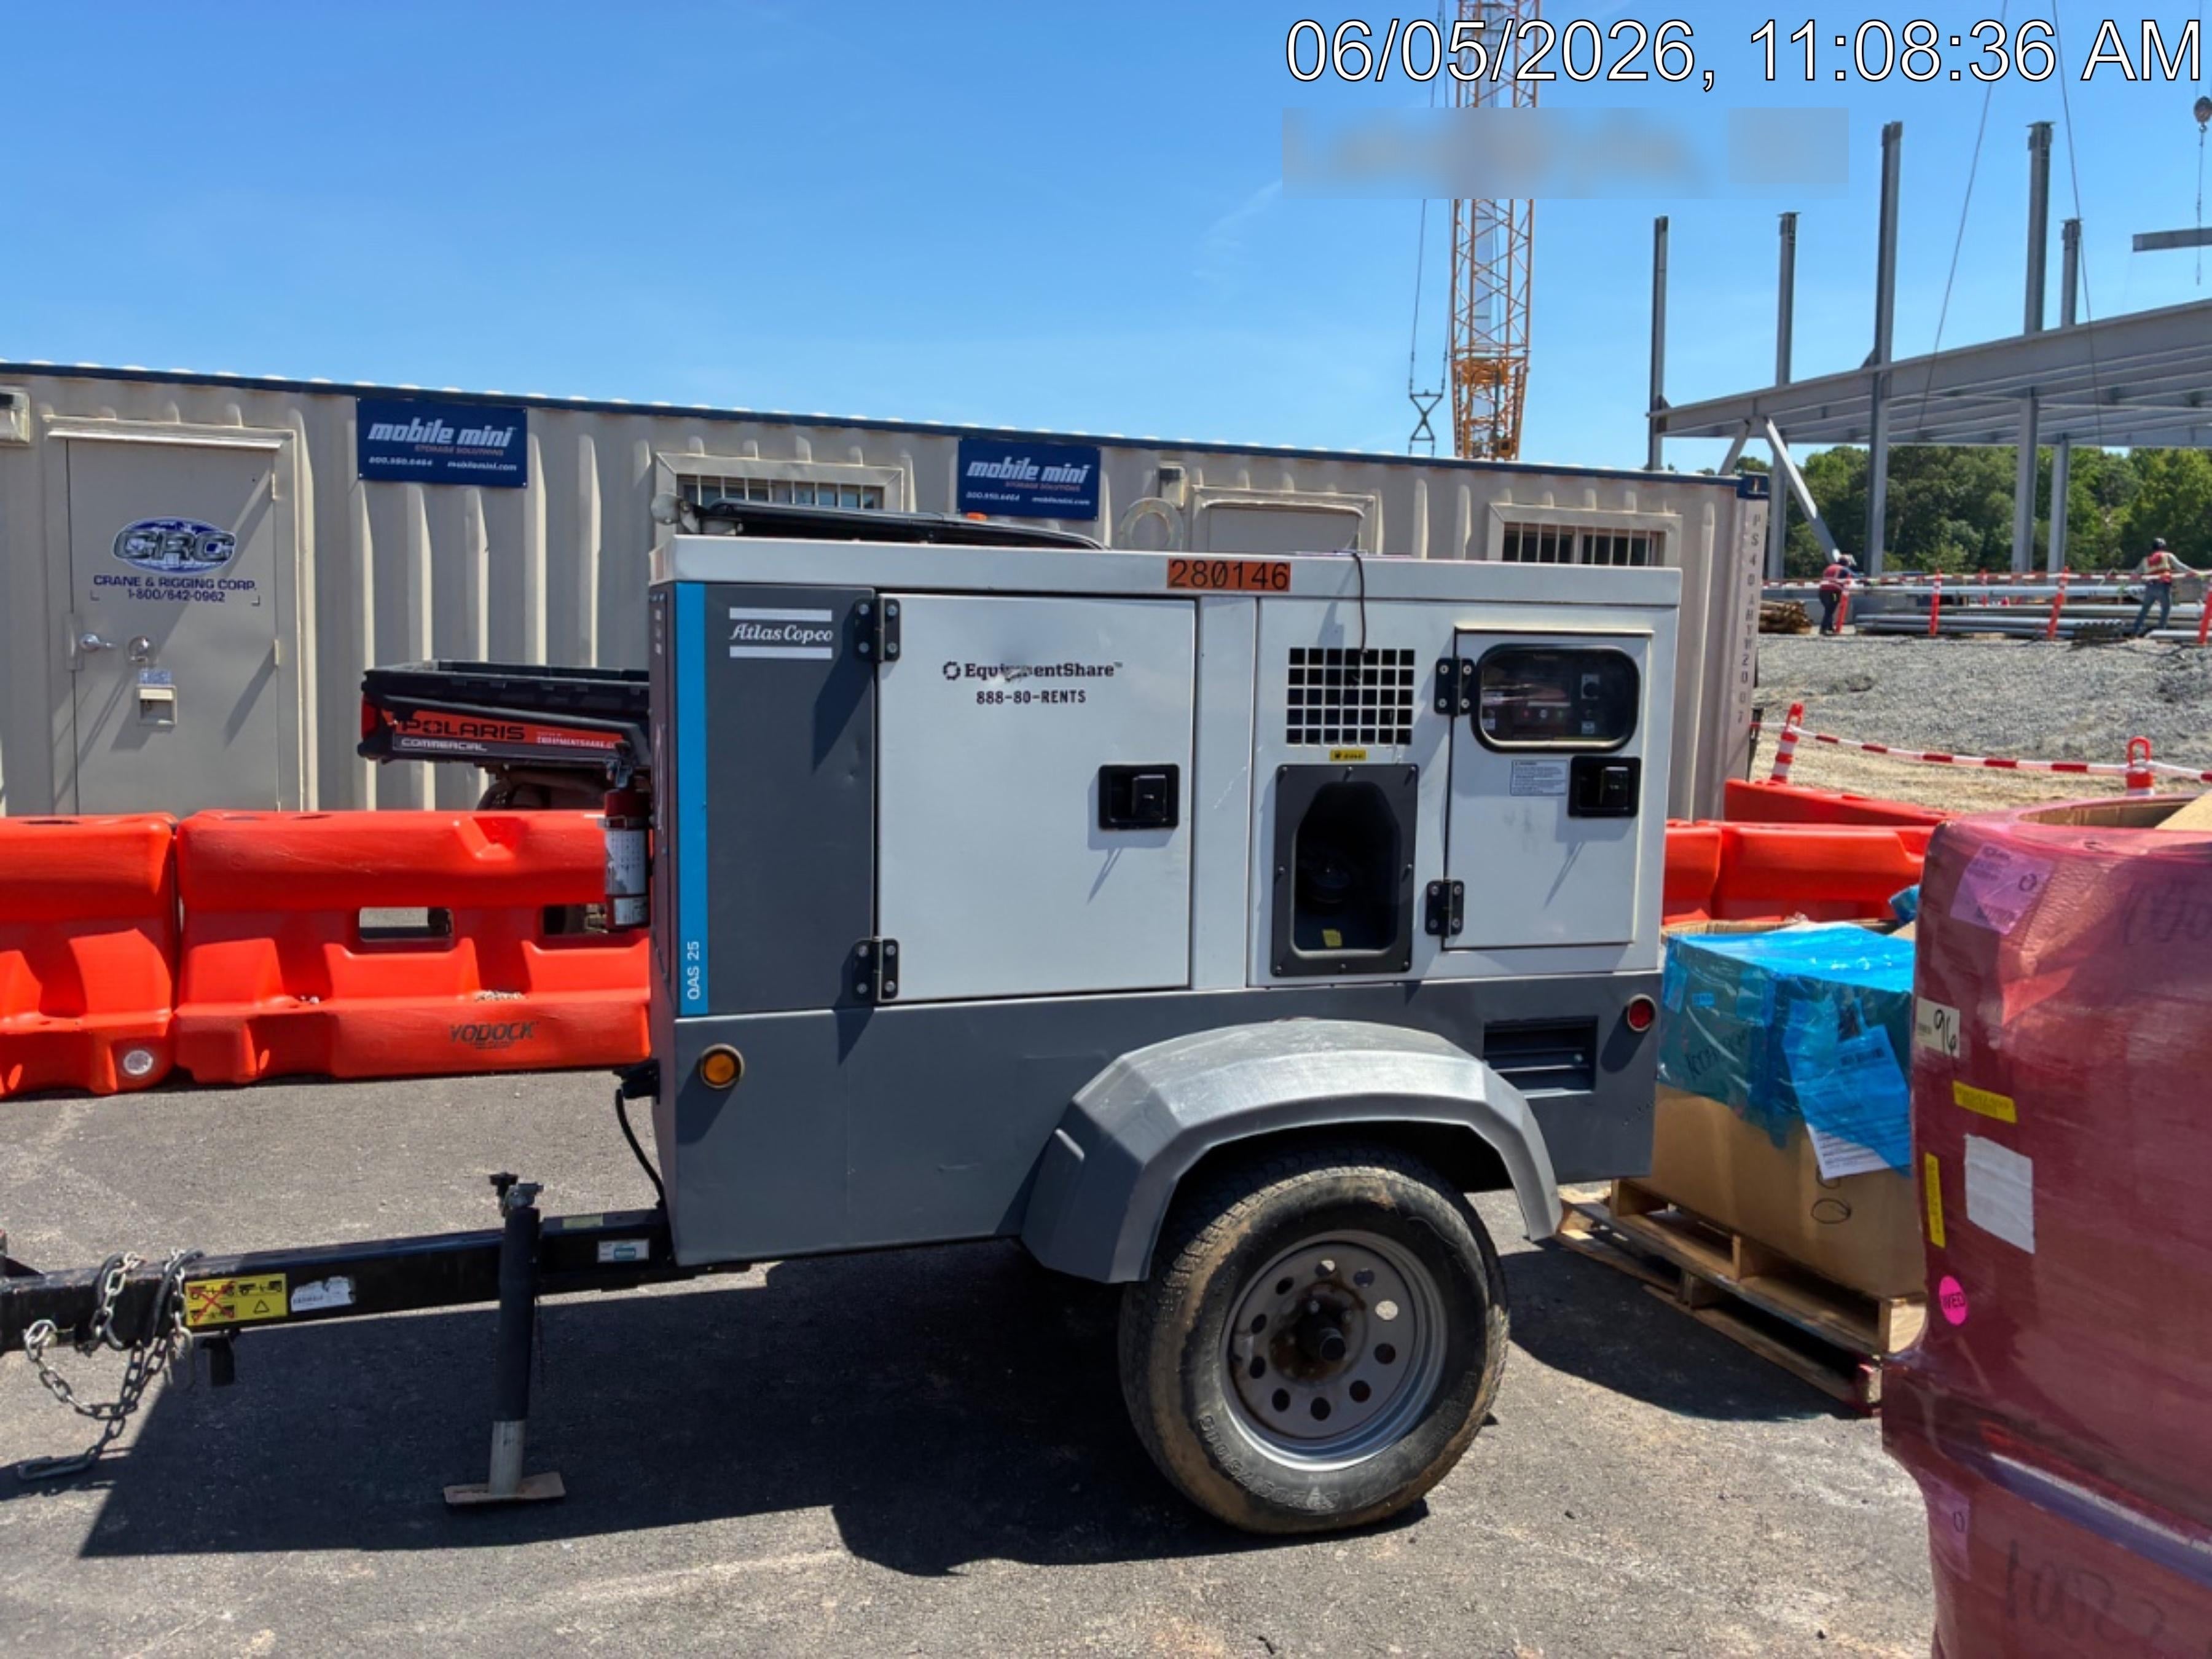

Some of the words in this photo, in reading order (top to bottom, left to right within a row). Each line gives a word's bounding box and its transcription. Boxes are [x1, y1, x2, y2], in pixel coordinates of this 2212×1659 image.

[367, 417, 454, 444] mobile
[457, 425, 514, 447] mini
[966, 456, 1040, 480] mobile
[1041, 463, 1091, 484] mini
[114, 530, 235, 562] CRC
[93, 575, 141, 587] CRANE
[146, 578, 155, 587] &
[159, 577, 214, 590] RIGGING
[218, 579, 257, 591] CORP.
[1169, 559, 1288, 590] 280146
[127, 587, 226, 602] 1-800/642-0962
[729, 622, 782, 641] Atlas
[783, 624, 834, 644] Copco
[976, 689, 1086, 705] 888-80-RENTS
[401, 719, 525, 740] POLARIS
[401, 737, 487, 752] COMMERCIAL
[687, 941, 699, 960] 25
[687, 965, 700, 1000] QAS
[449, 1021, 536, 1043] YODOCK
